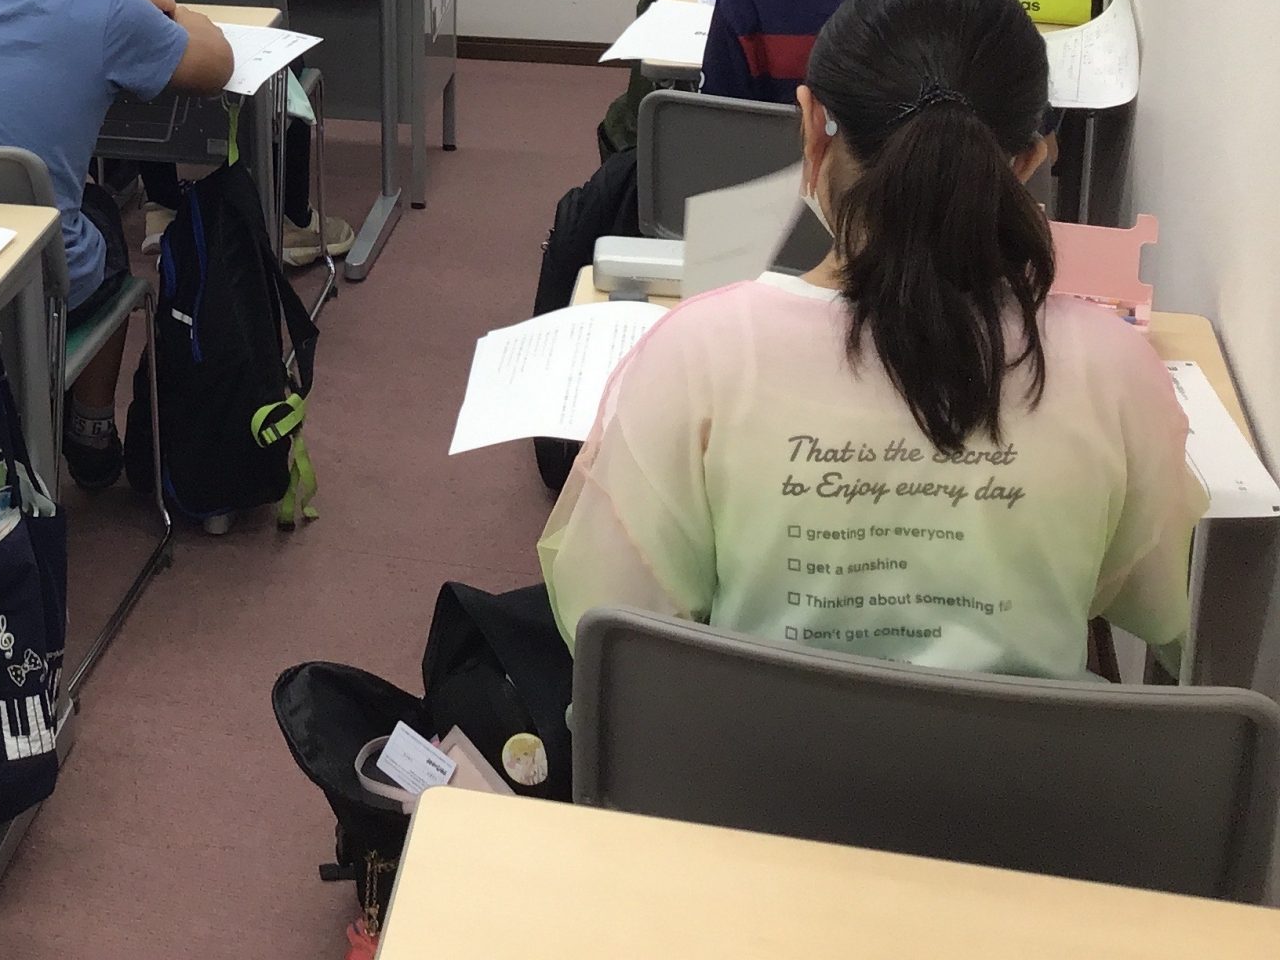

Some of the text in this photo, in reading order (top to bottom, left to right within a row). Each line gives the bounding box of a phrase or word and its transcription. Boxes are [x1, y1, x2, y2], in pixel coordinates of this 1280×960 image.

[788, 435, 856, 463] That
[857, 442, 876, 463] is
[884, 438, 924, 462] the
[782, 471, 1026, 509] to Enjoy every day
[806, 525, 965, 541] greeting for everyone
[806, 558, 908, 575] get a sunshine
[806, 594, 864, 609] Thinking
[869, 593, 911, 606] about
[915, 593, 995, 615] something
[803, 626, 942, 641] Don't get confused
